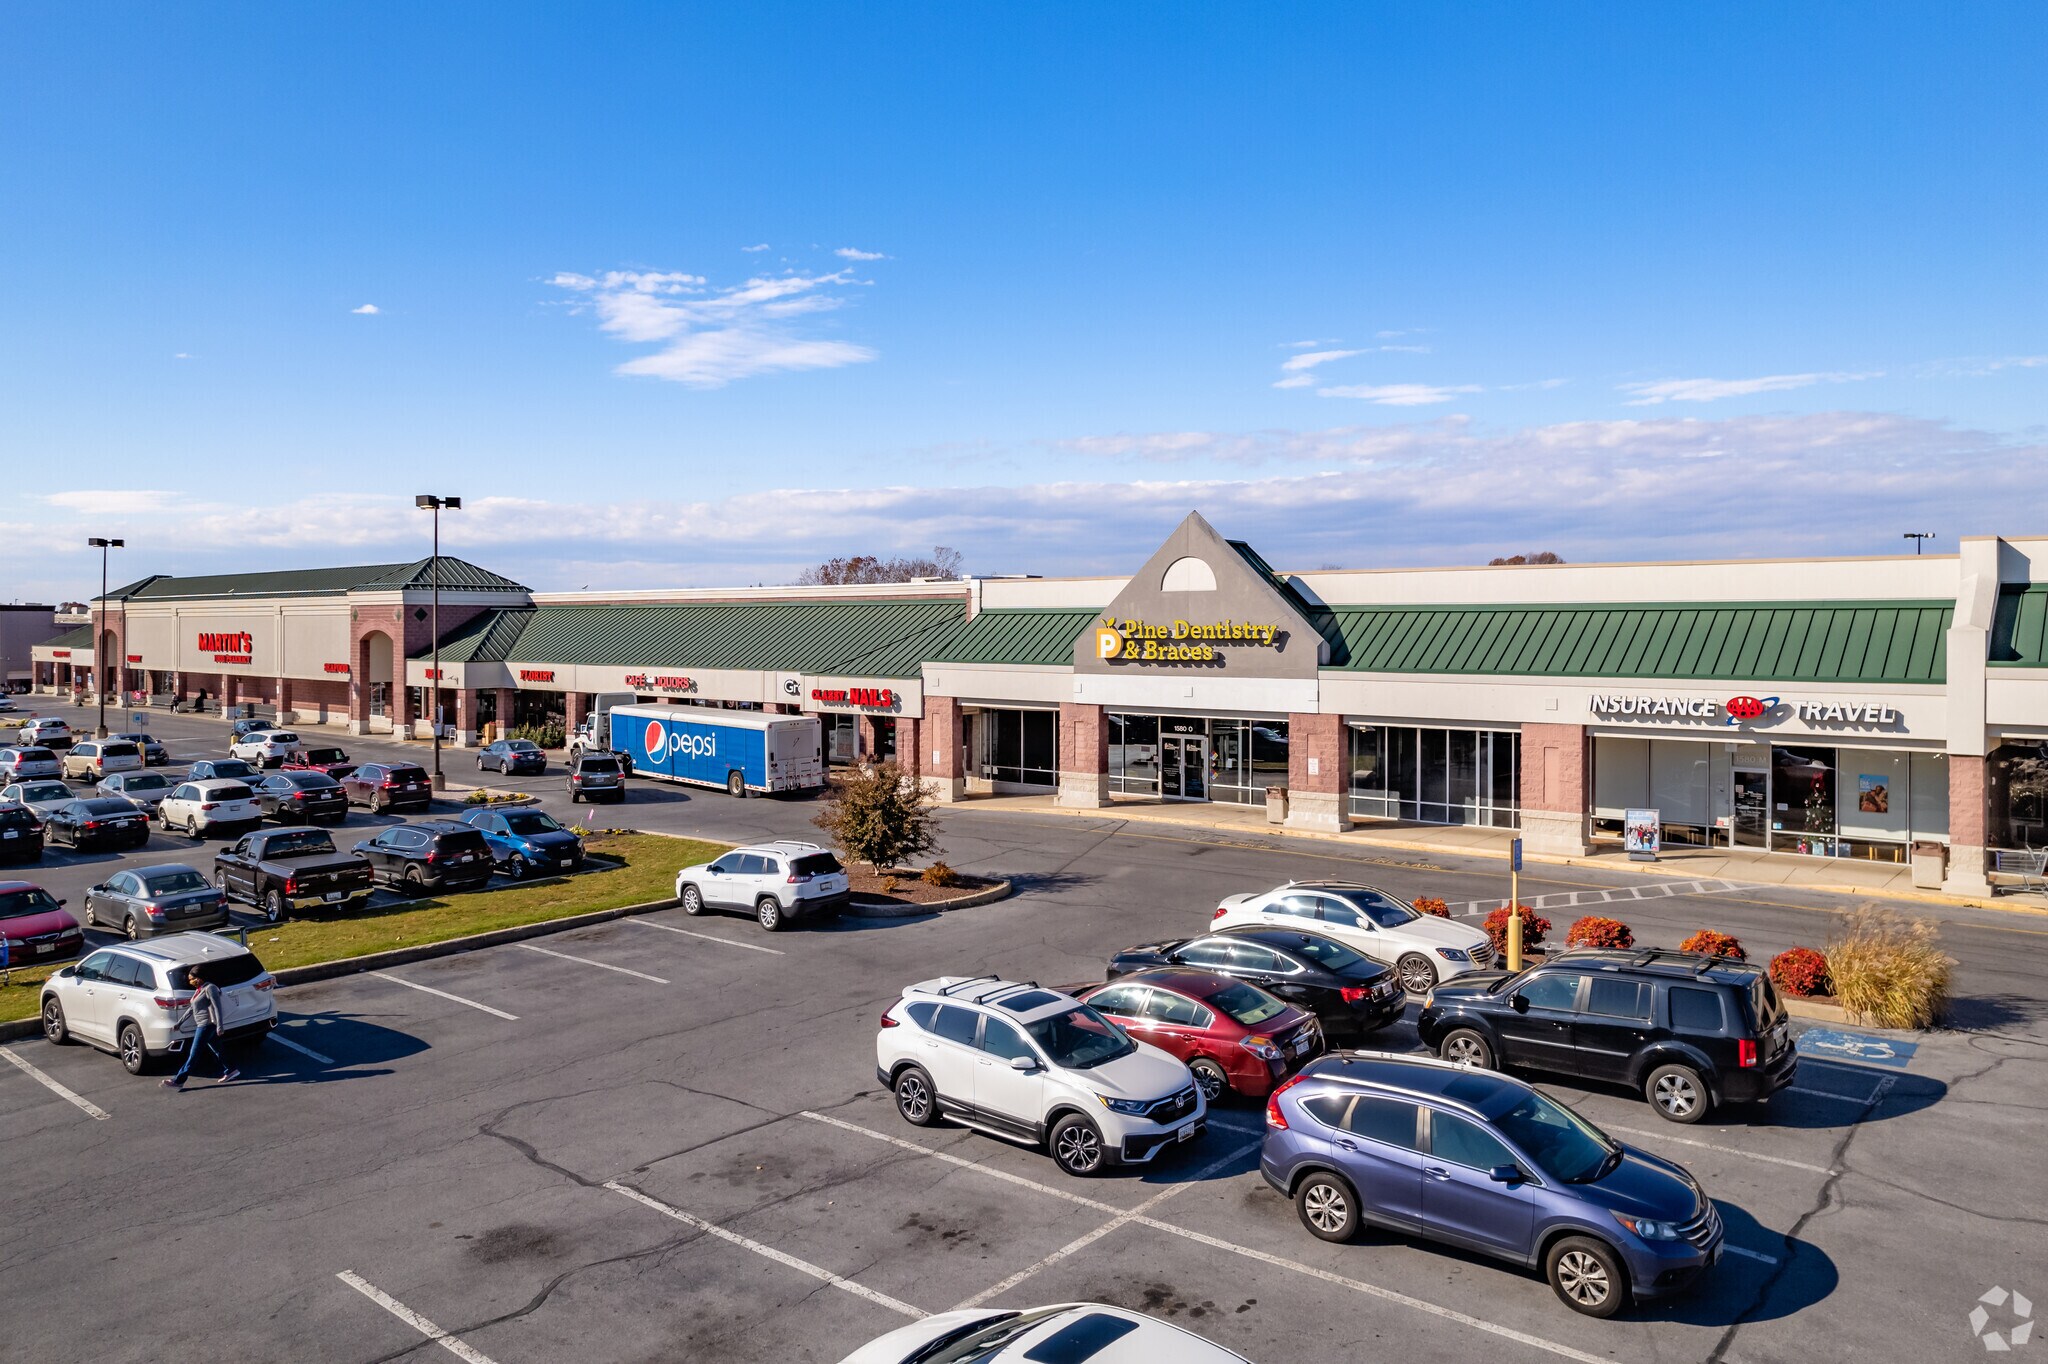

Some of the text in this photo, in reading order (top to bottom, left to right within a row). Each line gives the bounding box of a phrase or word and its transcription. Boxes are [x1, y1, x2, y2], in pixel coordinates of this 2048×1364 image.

[198, 631, 253, 653] MARTIN'S
[1125, 619, 1277, 644] Pine Dentistry
[1125, 641, 1213, 660] & Braces
[519, 669, 554, 683] FLORIST
[625, 673, 690, 689] CAFÉ LIQUORS
[811, 687, 892, 707] CLASSY NAILS
[1587, 694, 1896, 723] INSURANCE AAA TRAVEL
[668, 731, 716, 760] pepsi
